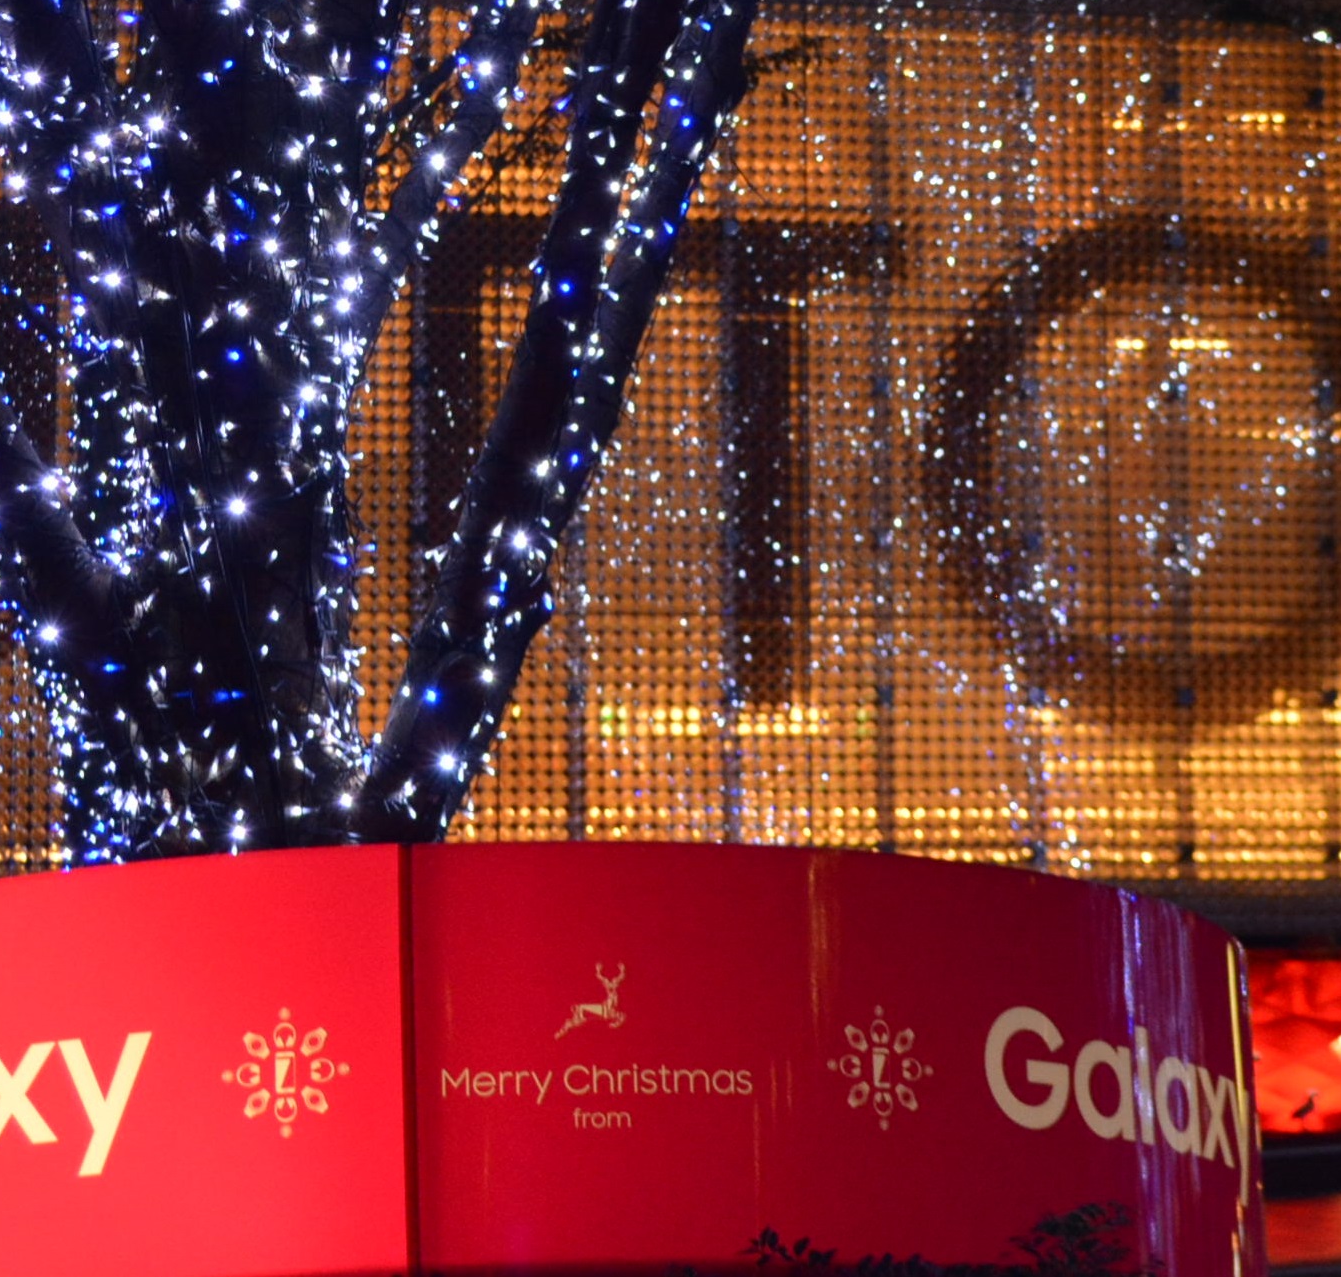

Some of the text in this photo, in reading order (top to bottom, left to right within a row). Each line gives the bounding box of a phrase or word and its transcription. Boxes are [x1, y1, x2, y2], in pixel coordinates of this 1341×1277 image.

[441, 1063, 754, 1105] Merry Christmas
[572, 1107, 633, 1129] from
[984, 1005, 1249, 1208] Galaxy
